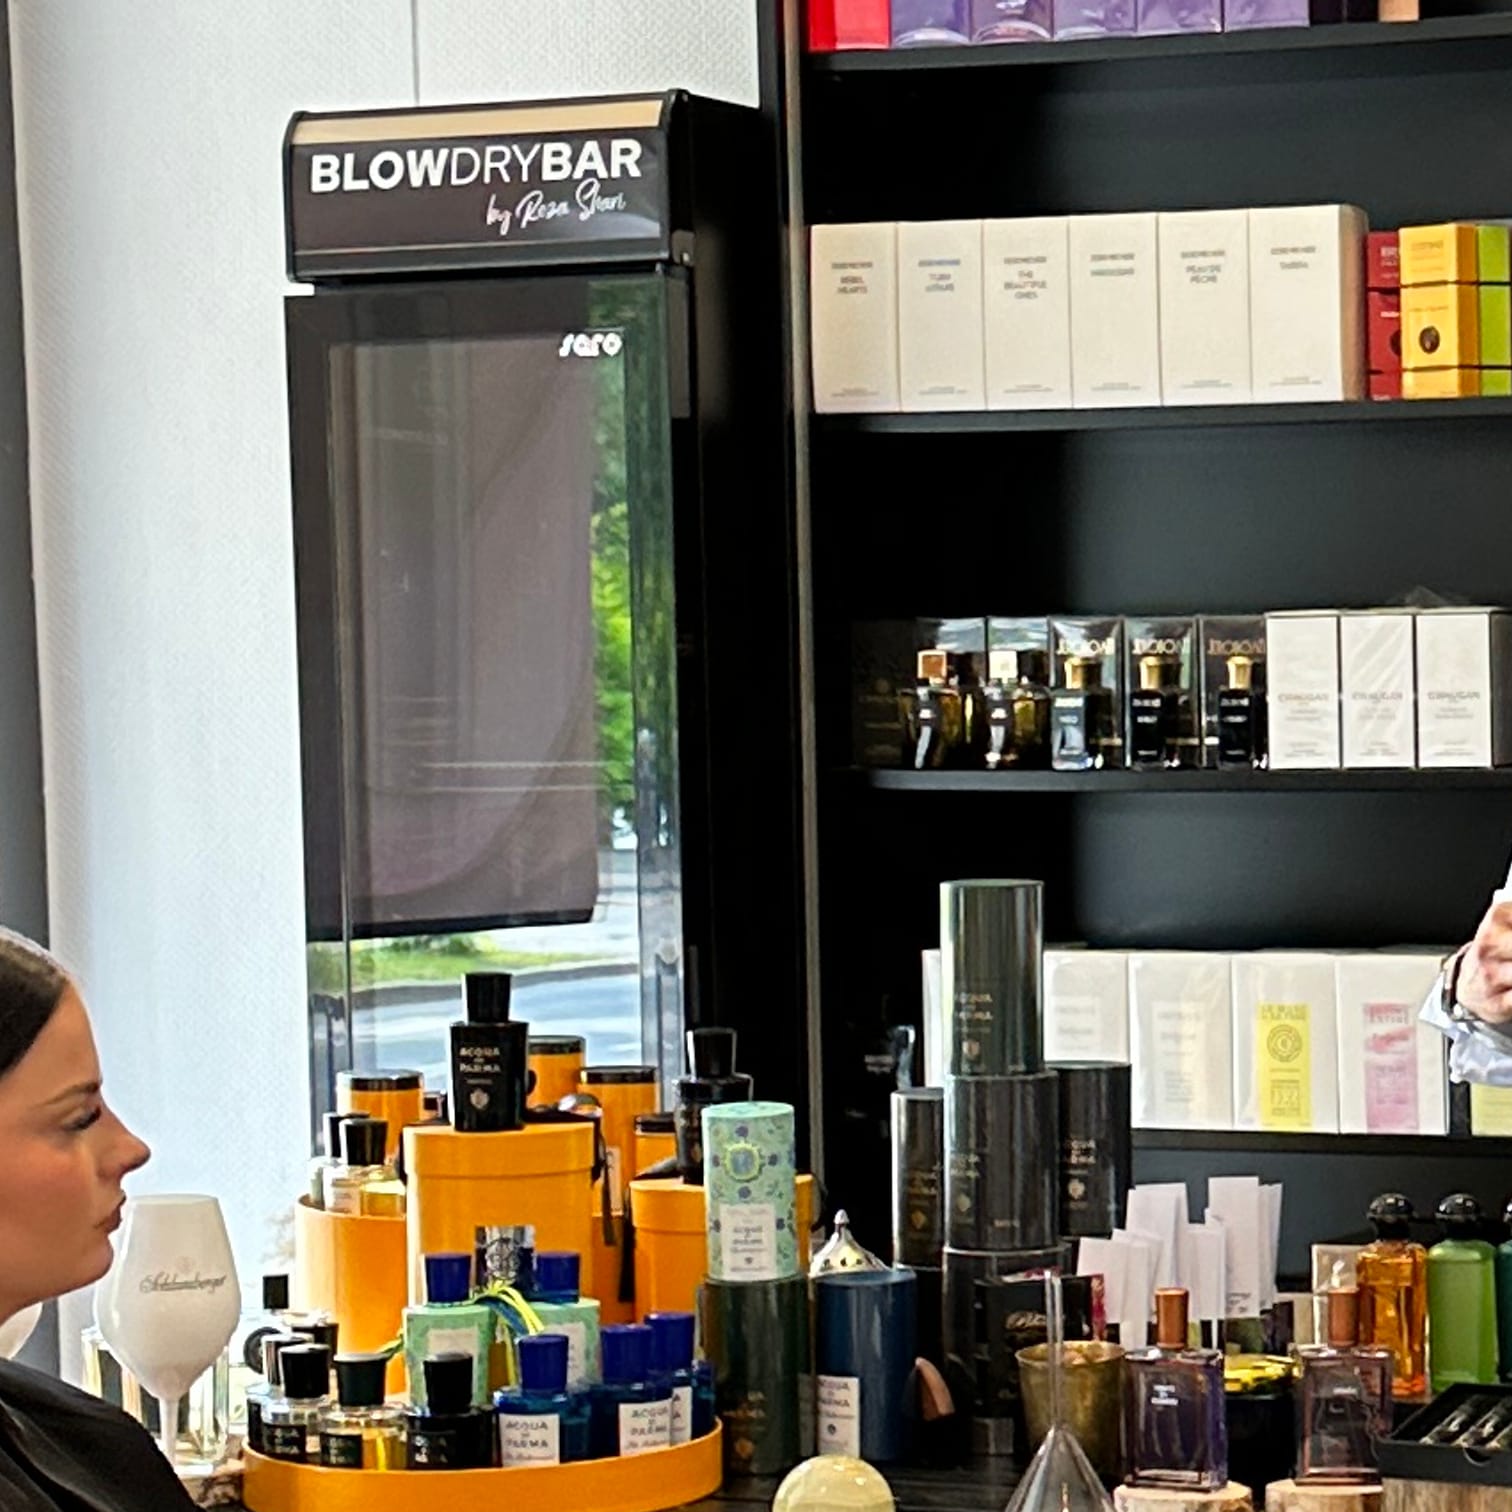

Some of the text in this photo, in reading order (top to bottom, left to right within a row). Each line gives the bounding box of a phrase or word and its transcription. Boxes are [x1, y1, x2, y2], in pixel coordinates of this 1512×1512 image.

[311, 139, 642, 193] BLOWDRYBAR
[486, 193, 513, 237] by
[515, 189, 570, 230] Reza
[459, 1047, 501, 1057] ACQUA
[459, 1063, 501, 1073] PARMA
[505, 1420, 548, 1430] ACQUA
[505, 1439, 548, 1449] PARMA
